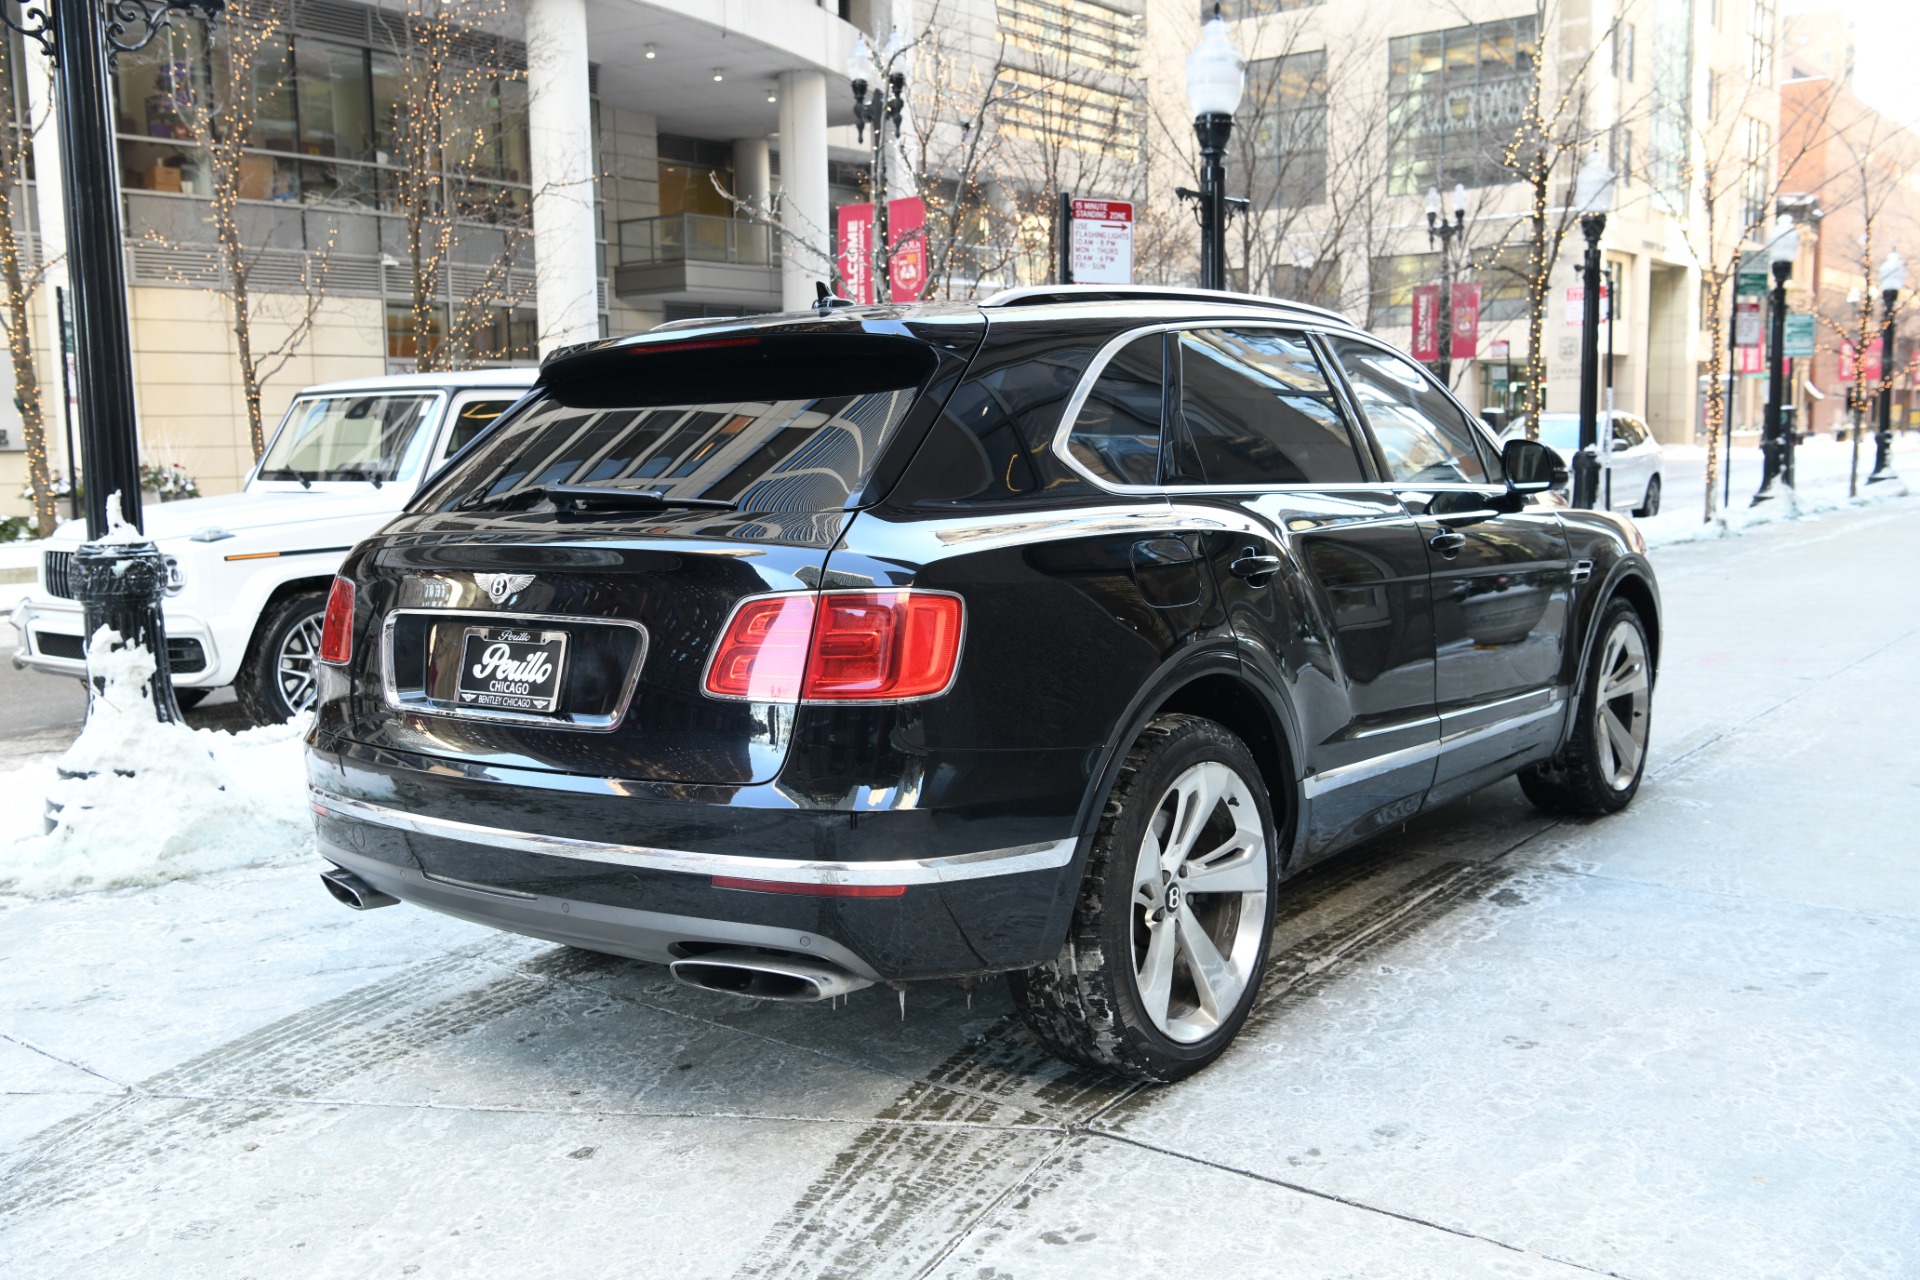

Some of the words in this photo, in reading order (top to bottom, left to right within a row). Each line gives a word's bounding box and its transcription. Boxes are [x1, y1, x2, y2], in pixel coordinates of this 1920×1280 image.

[1075, 201, 1083, 210] 15
[1083, 202, 1108, 212] MINUTE
[1075, 209, 1107, 219] STANDING
[1109, 212, 1127, 220] ZONE
[1075, 222, 1088, 230] USE
[1075, 231, 1106, 239] FLASHING
[1107, 232, 1130, 240] LIGHTS
[1097, 247, 1119, 255] THURS
[847, 220, 858, 299] ELCOME
[498, 629, 531, 641] Perillo
[472, 643, 552, 684] Perillo
[489, 680, 529, 695] CHICAGO
[478, 694, 502, 705] BENTLEY
[502, 697, 531, 708] CHICAGO
[1169, 887, 1180, 908] B
